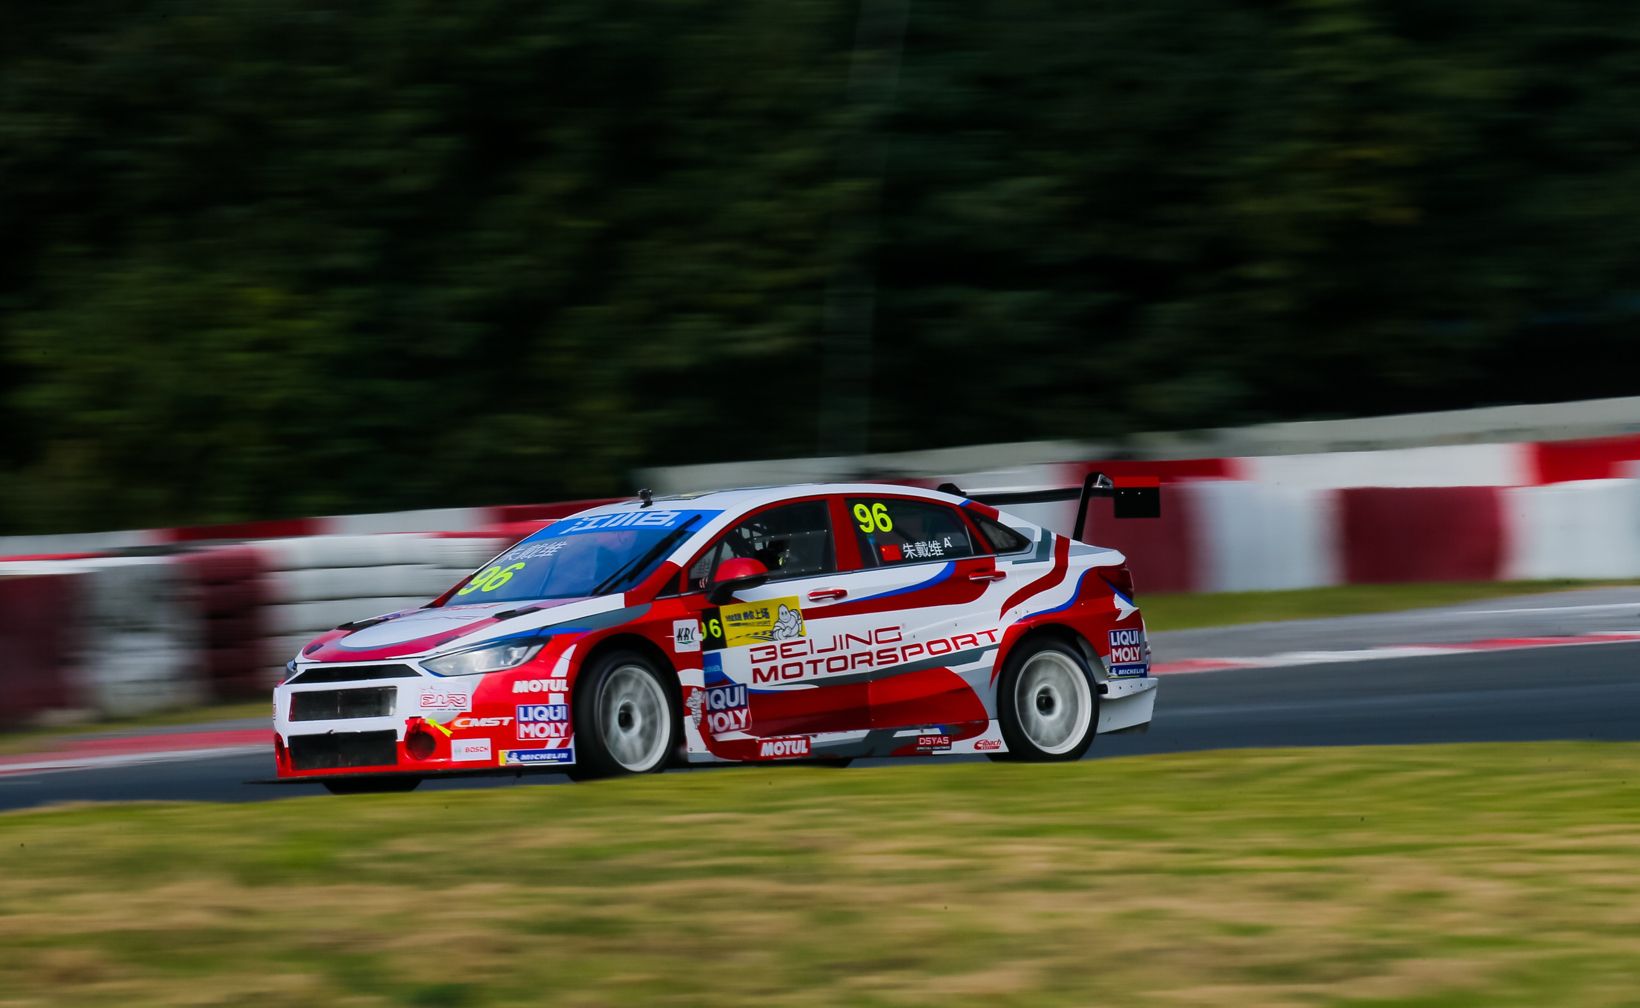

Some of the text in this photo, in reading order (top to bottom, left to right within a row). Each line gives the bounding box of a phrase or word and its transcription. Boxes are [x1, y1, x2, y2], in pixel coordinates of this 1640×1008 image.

[853, 503, 893, 533] 96
[902, 540, 944, 559] 朱戴维
[457, 562, 525, 596] 96
[750, 626, 902, 664] BEIJING
[1110, 630, 1139, 646] LIQUI
[752, 629, 999, 684] MOTORSPORT
[1112, 646, 1140, 662] MOLY
[512, 679, 569, 693] MOTUL
[454, 716, 514, 727] CMST
[519, 706, 567, 722] LIQUI
[519, 722, 568, 738] MOLY
[760, 739, 808, 757] MOTUL
[520, 752, 568, 761] MICHELIN
